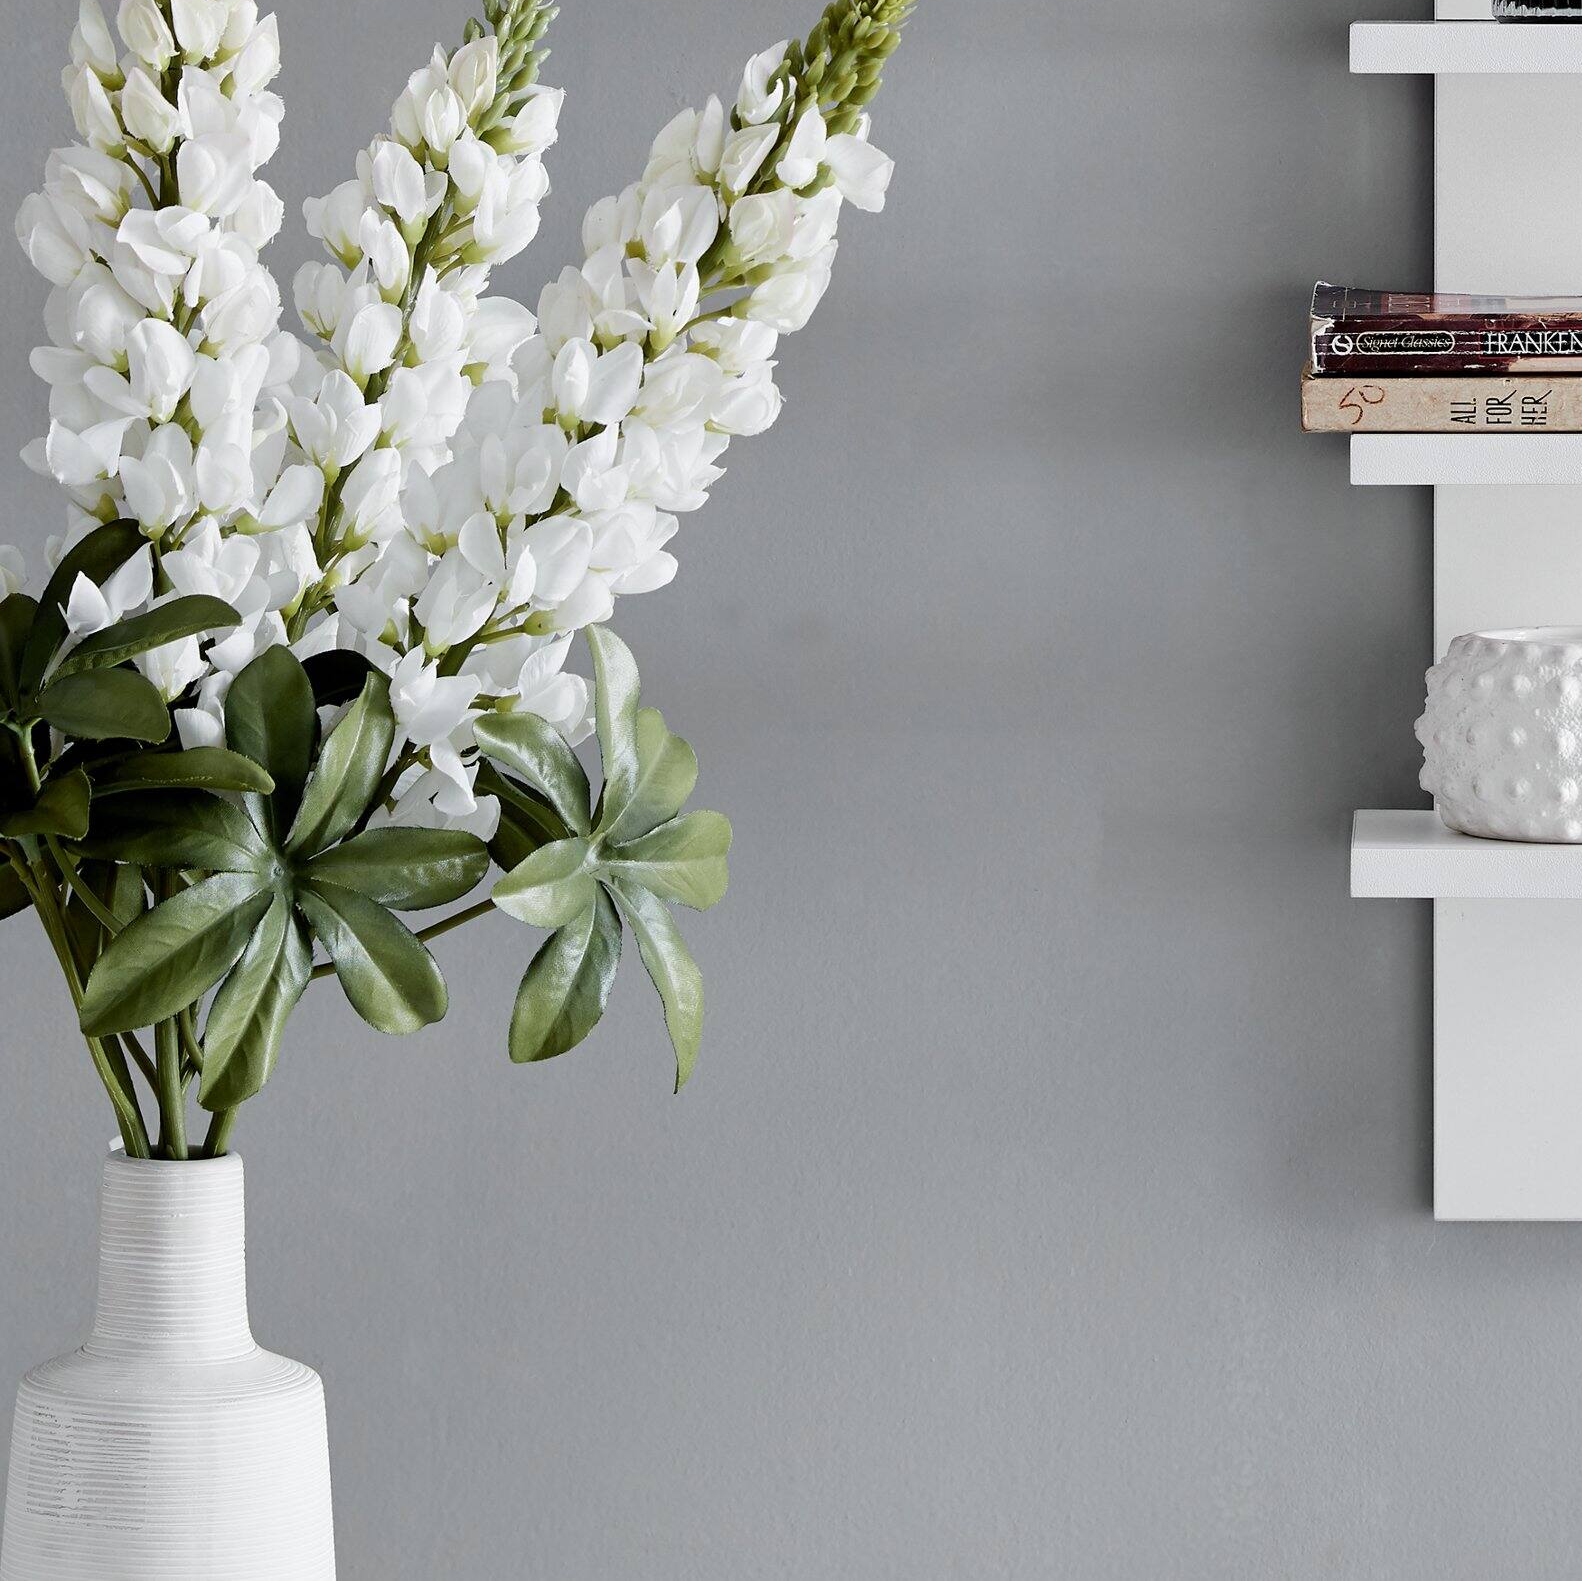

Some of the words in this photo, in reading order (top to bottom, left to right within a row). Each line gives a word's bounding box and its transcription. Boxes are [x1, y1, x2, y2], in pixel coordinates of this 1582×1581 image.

[1362, 335, 1398, 352] Signet
[1400, 335, 1451, 349] Classics
[1486, 389, 1517, 425] FOR
[1521, 389, 1553, 426] HER
